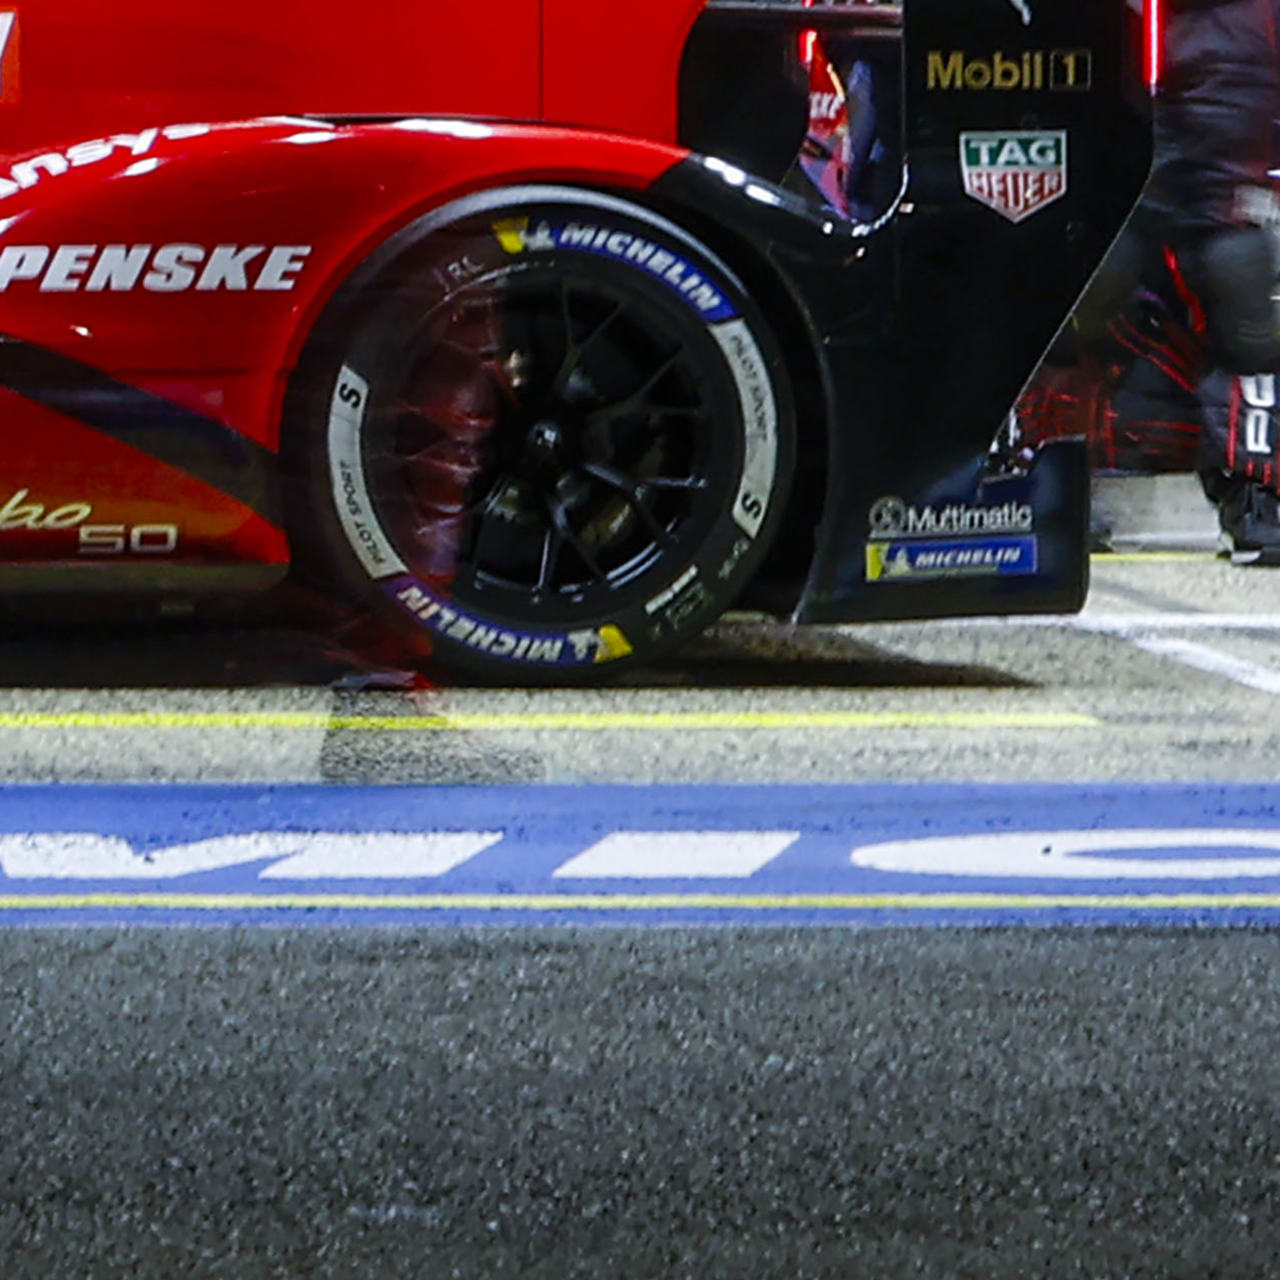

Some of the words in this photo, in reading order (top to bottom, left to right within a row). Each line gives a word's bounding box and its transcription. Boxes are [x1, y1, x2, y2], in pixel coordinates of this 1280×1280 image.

[926, 50, 1042, 90] Mobil
[968, 139, 1058, 165] TAG
[968, 171, 1063, 210] HEUER
[559, 222, 722, 311] MICHELIN
[77, 523, 180, 554] 50
[914, 547, 1022, 568] MICHELIN
[396, 585, 564, 662] MICHELIN
